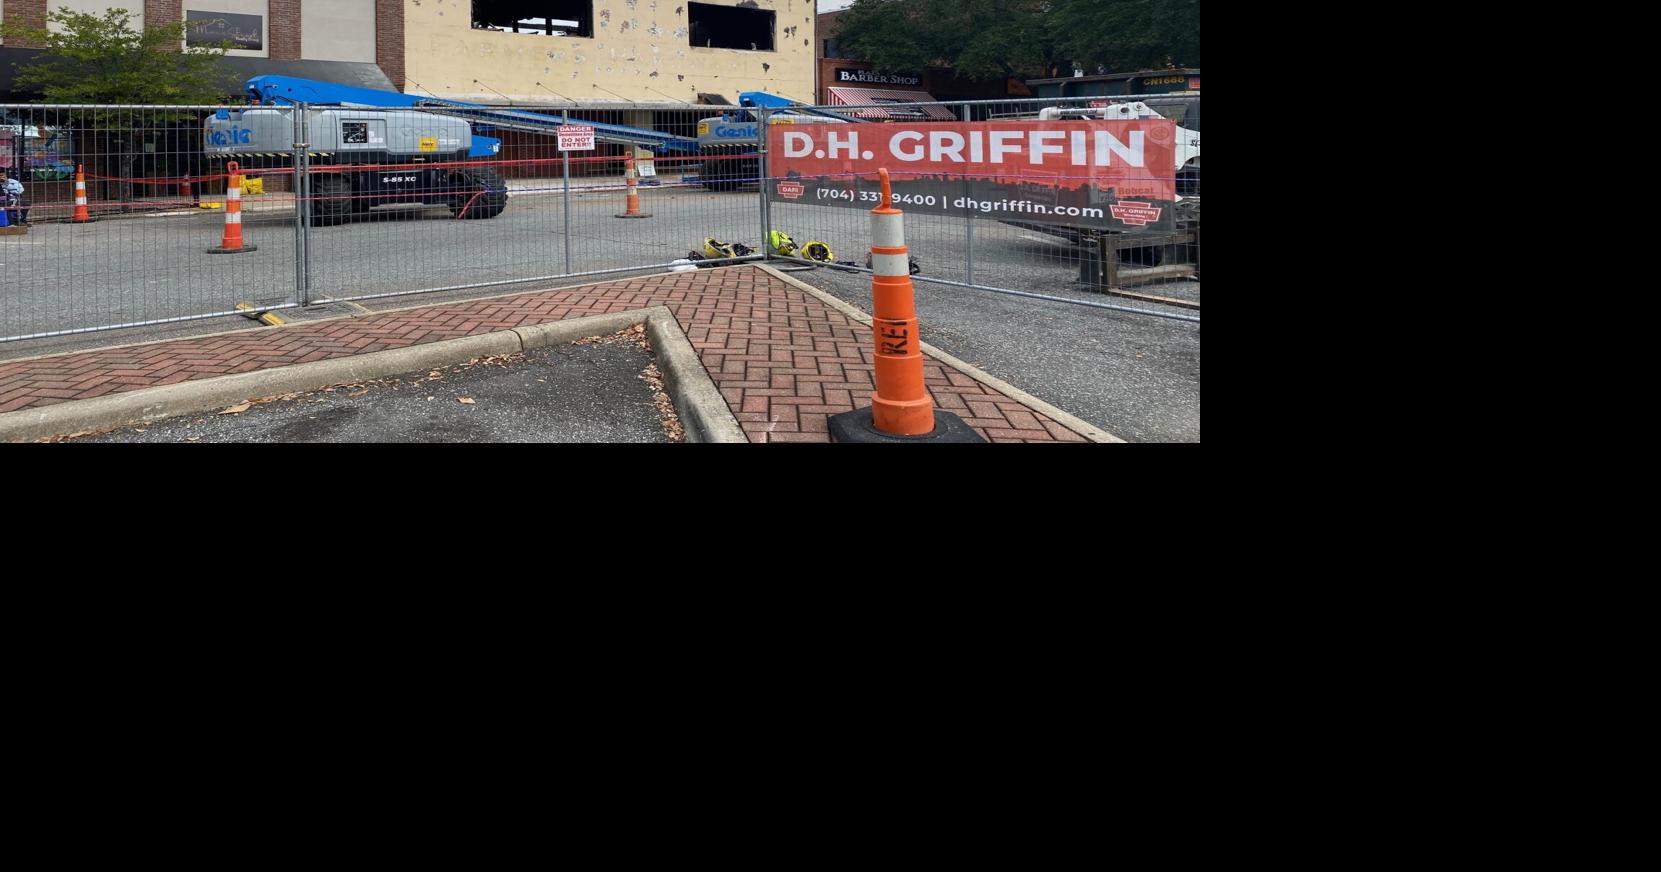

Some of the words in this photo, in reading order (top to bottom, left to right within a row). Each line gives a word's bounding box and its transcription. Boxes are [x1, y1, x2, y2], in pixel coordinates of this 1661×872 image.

[840, 71, 888, 84] BARBER
[890, 75, 919, 85] SHOP
[783, 131, 874, 160] D.H.
[888, 131, 1144, 168] GRIFFIN
[816, 187, 855, 202] (704)
[859, 191, 936, 206] 3319400
[953, 197, 1103, 218] dhgriffin.com
